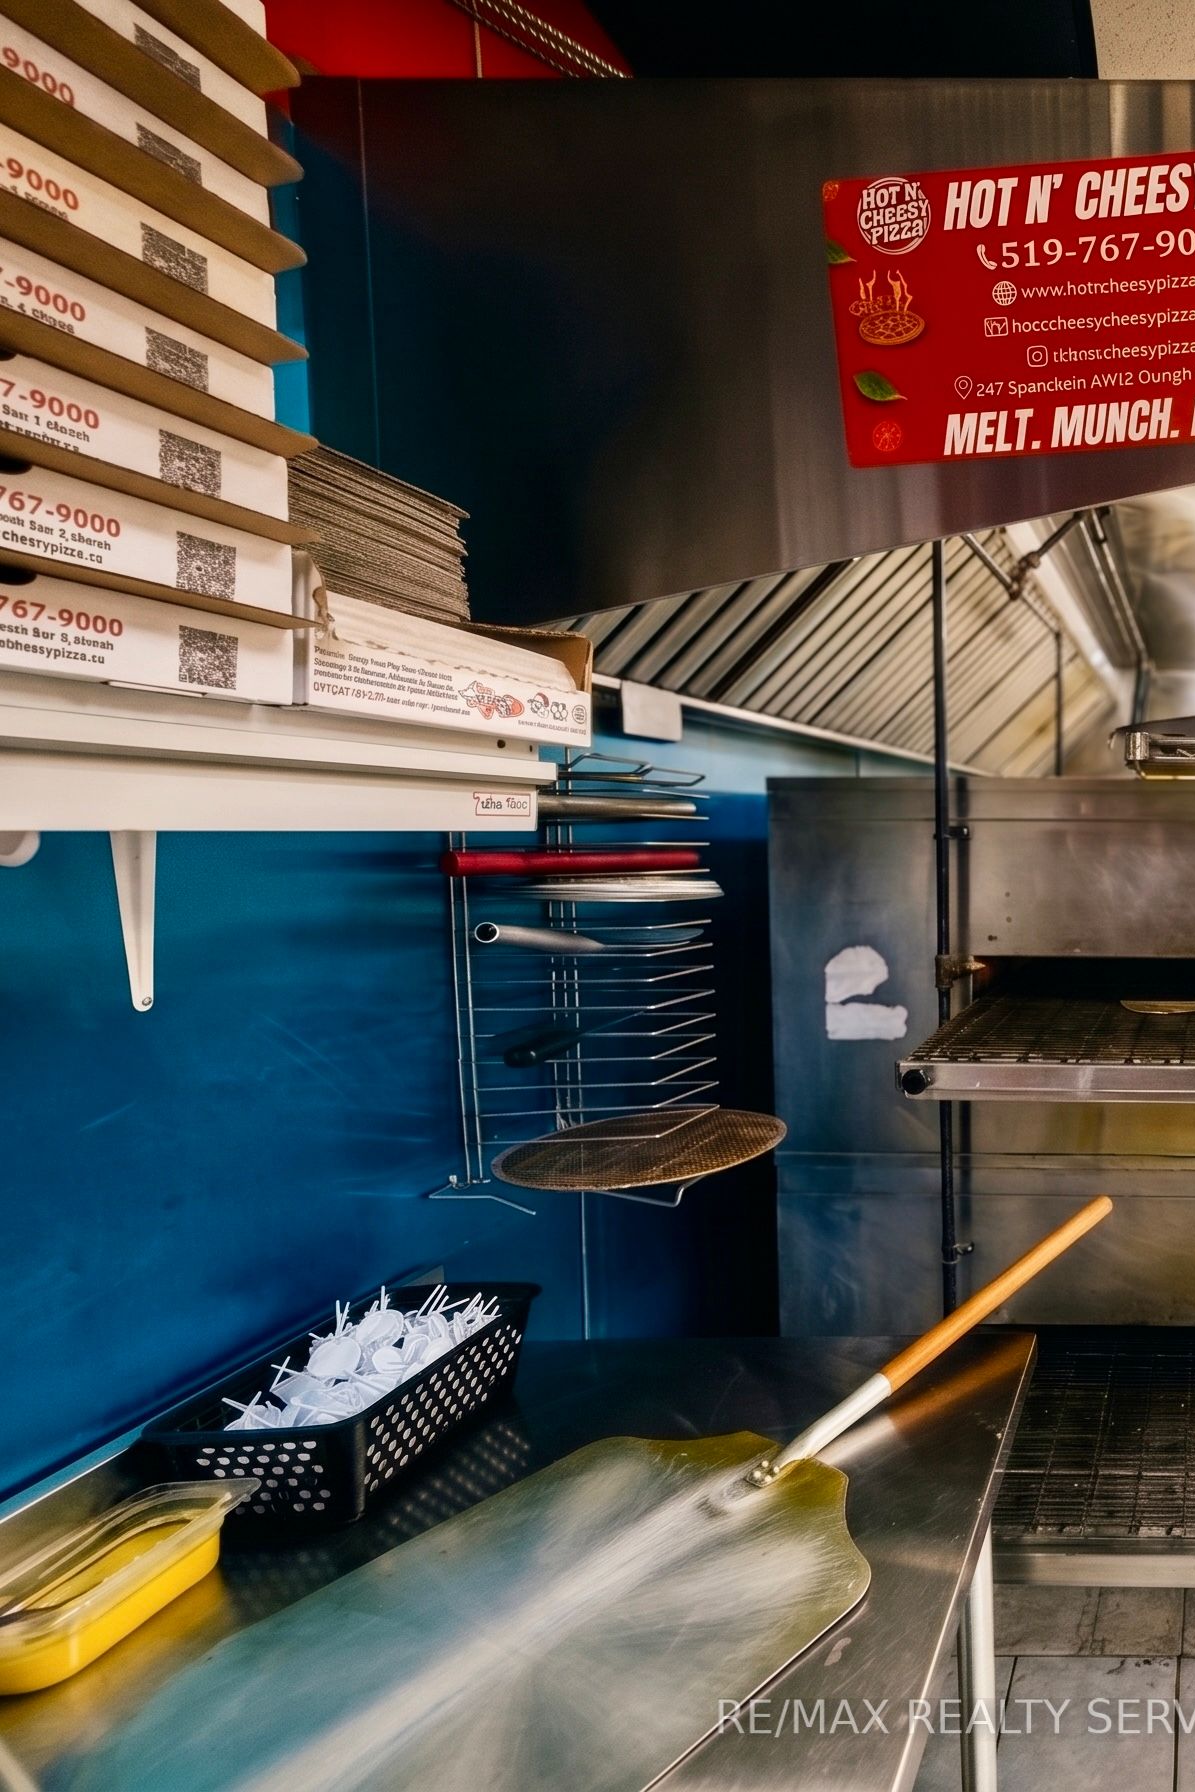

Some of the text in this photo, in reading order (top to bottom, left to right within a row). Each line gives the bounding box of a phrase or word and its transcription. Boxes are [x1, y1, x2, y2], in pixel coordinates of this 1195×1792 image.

[862, 186, 901, 210] HOT
[944, 178, 1019, 230] HOT
[860, 199, 929, 230] CHEESY
[976, 382, 1004, 397] 247
[1008, 376, 1086, 398] Spanckein
[1139, 367, 1192, 386] Oungh
[944, 408, 1041, 455] MELT.
[1051, 398, 1180, 447] MUNCH.
